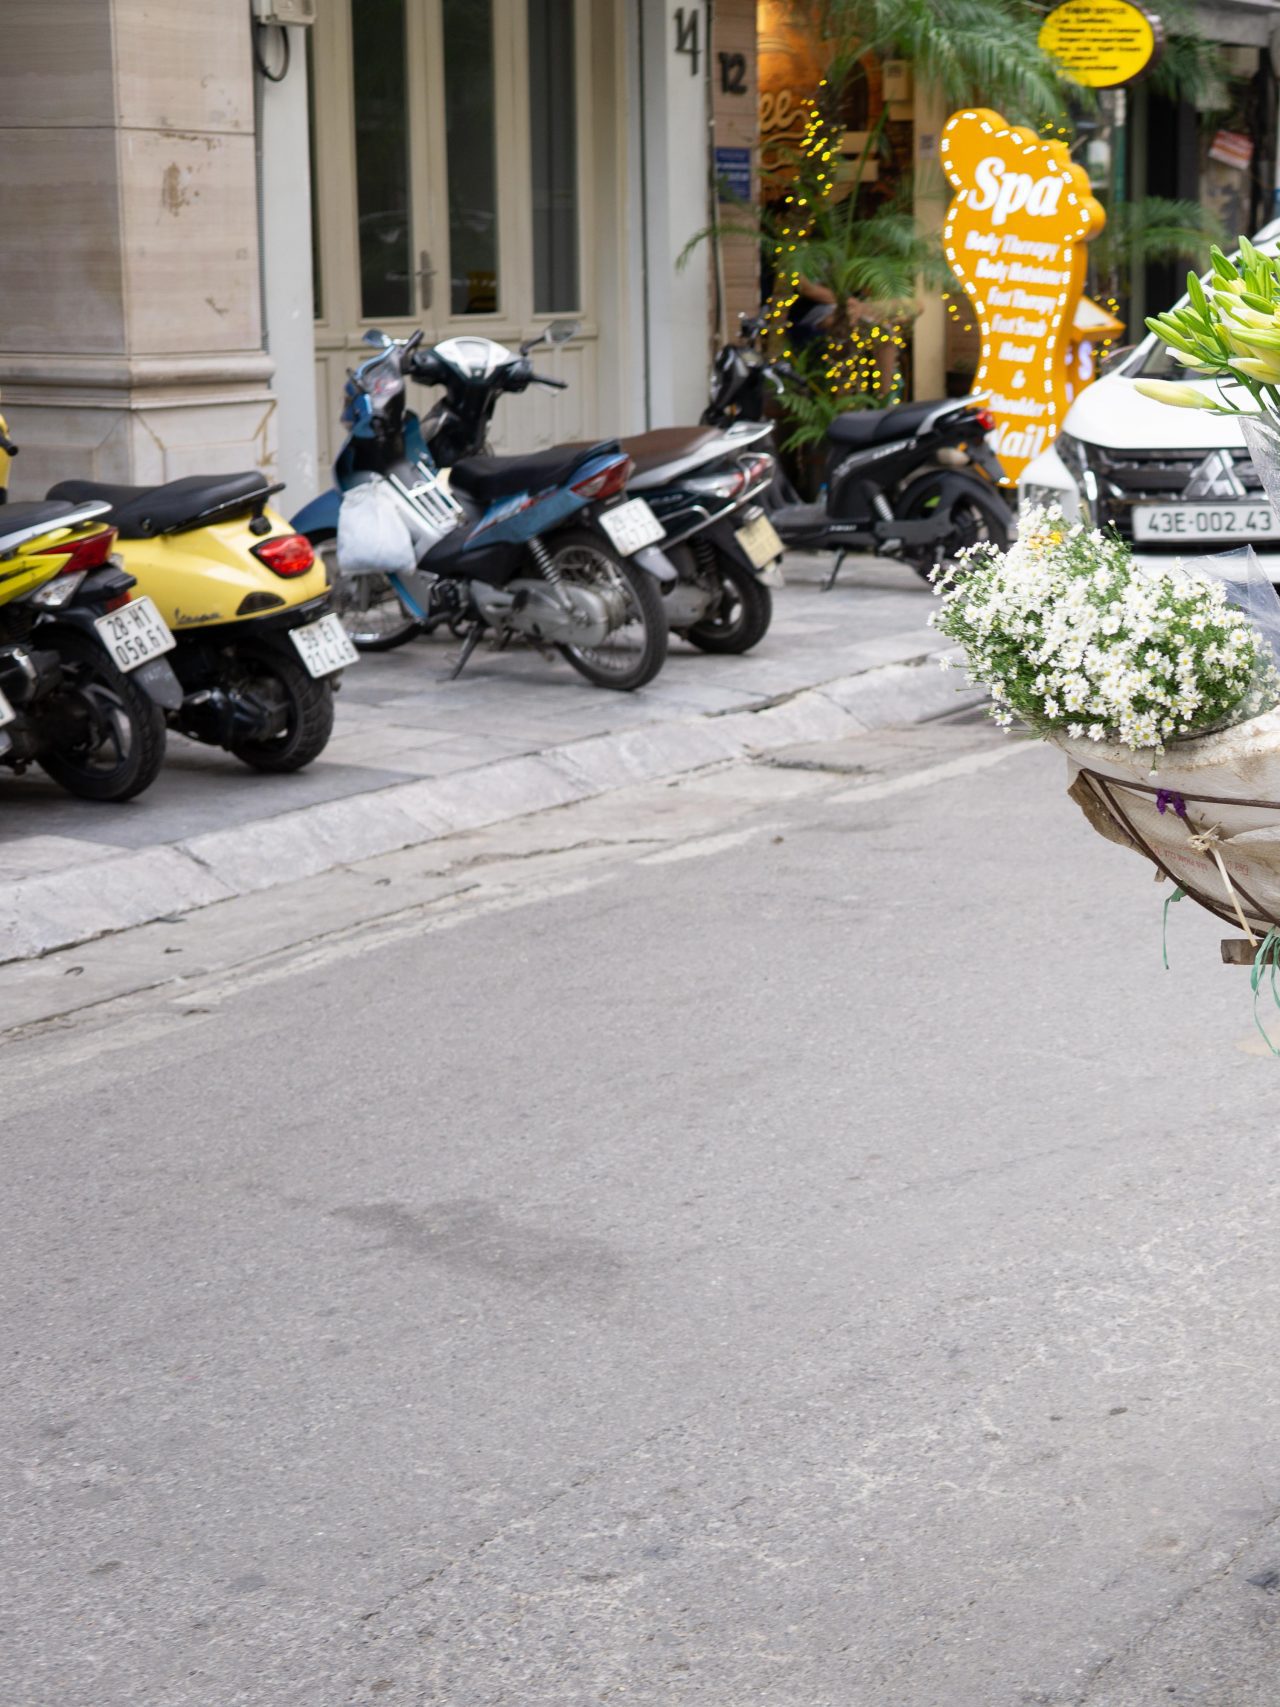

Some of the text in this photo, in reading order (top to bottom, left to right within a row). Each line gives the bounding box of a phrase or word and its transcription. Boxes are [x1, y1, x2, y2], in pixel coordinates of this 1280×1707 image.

[718, 51, 748, 94] 12
[966, 156, 1064, 226] Spa
[1148, 511, 1272, 532] 43E-002.43
[107, 605, 151, 640] 28-H1
